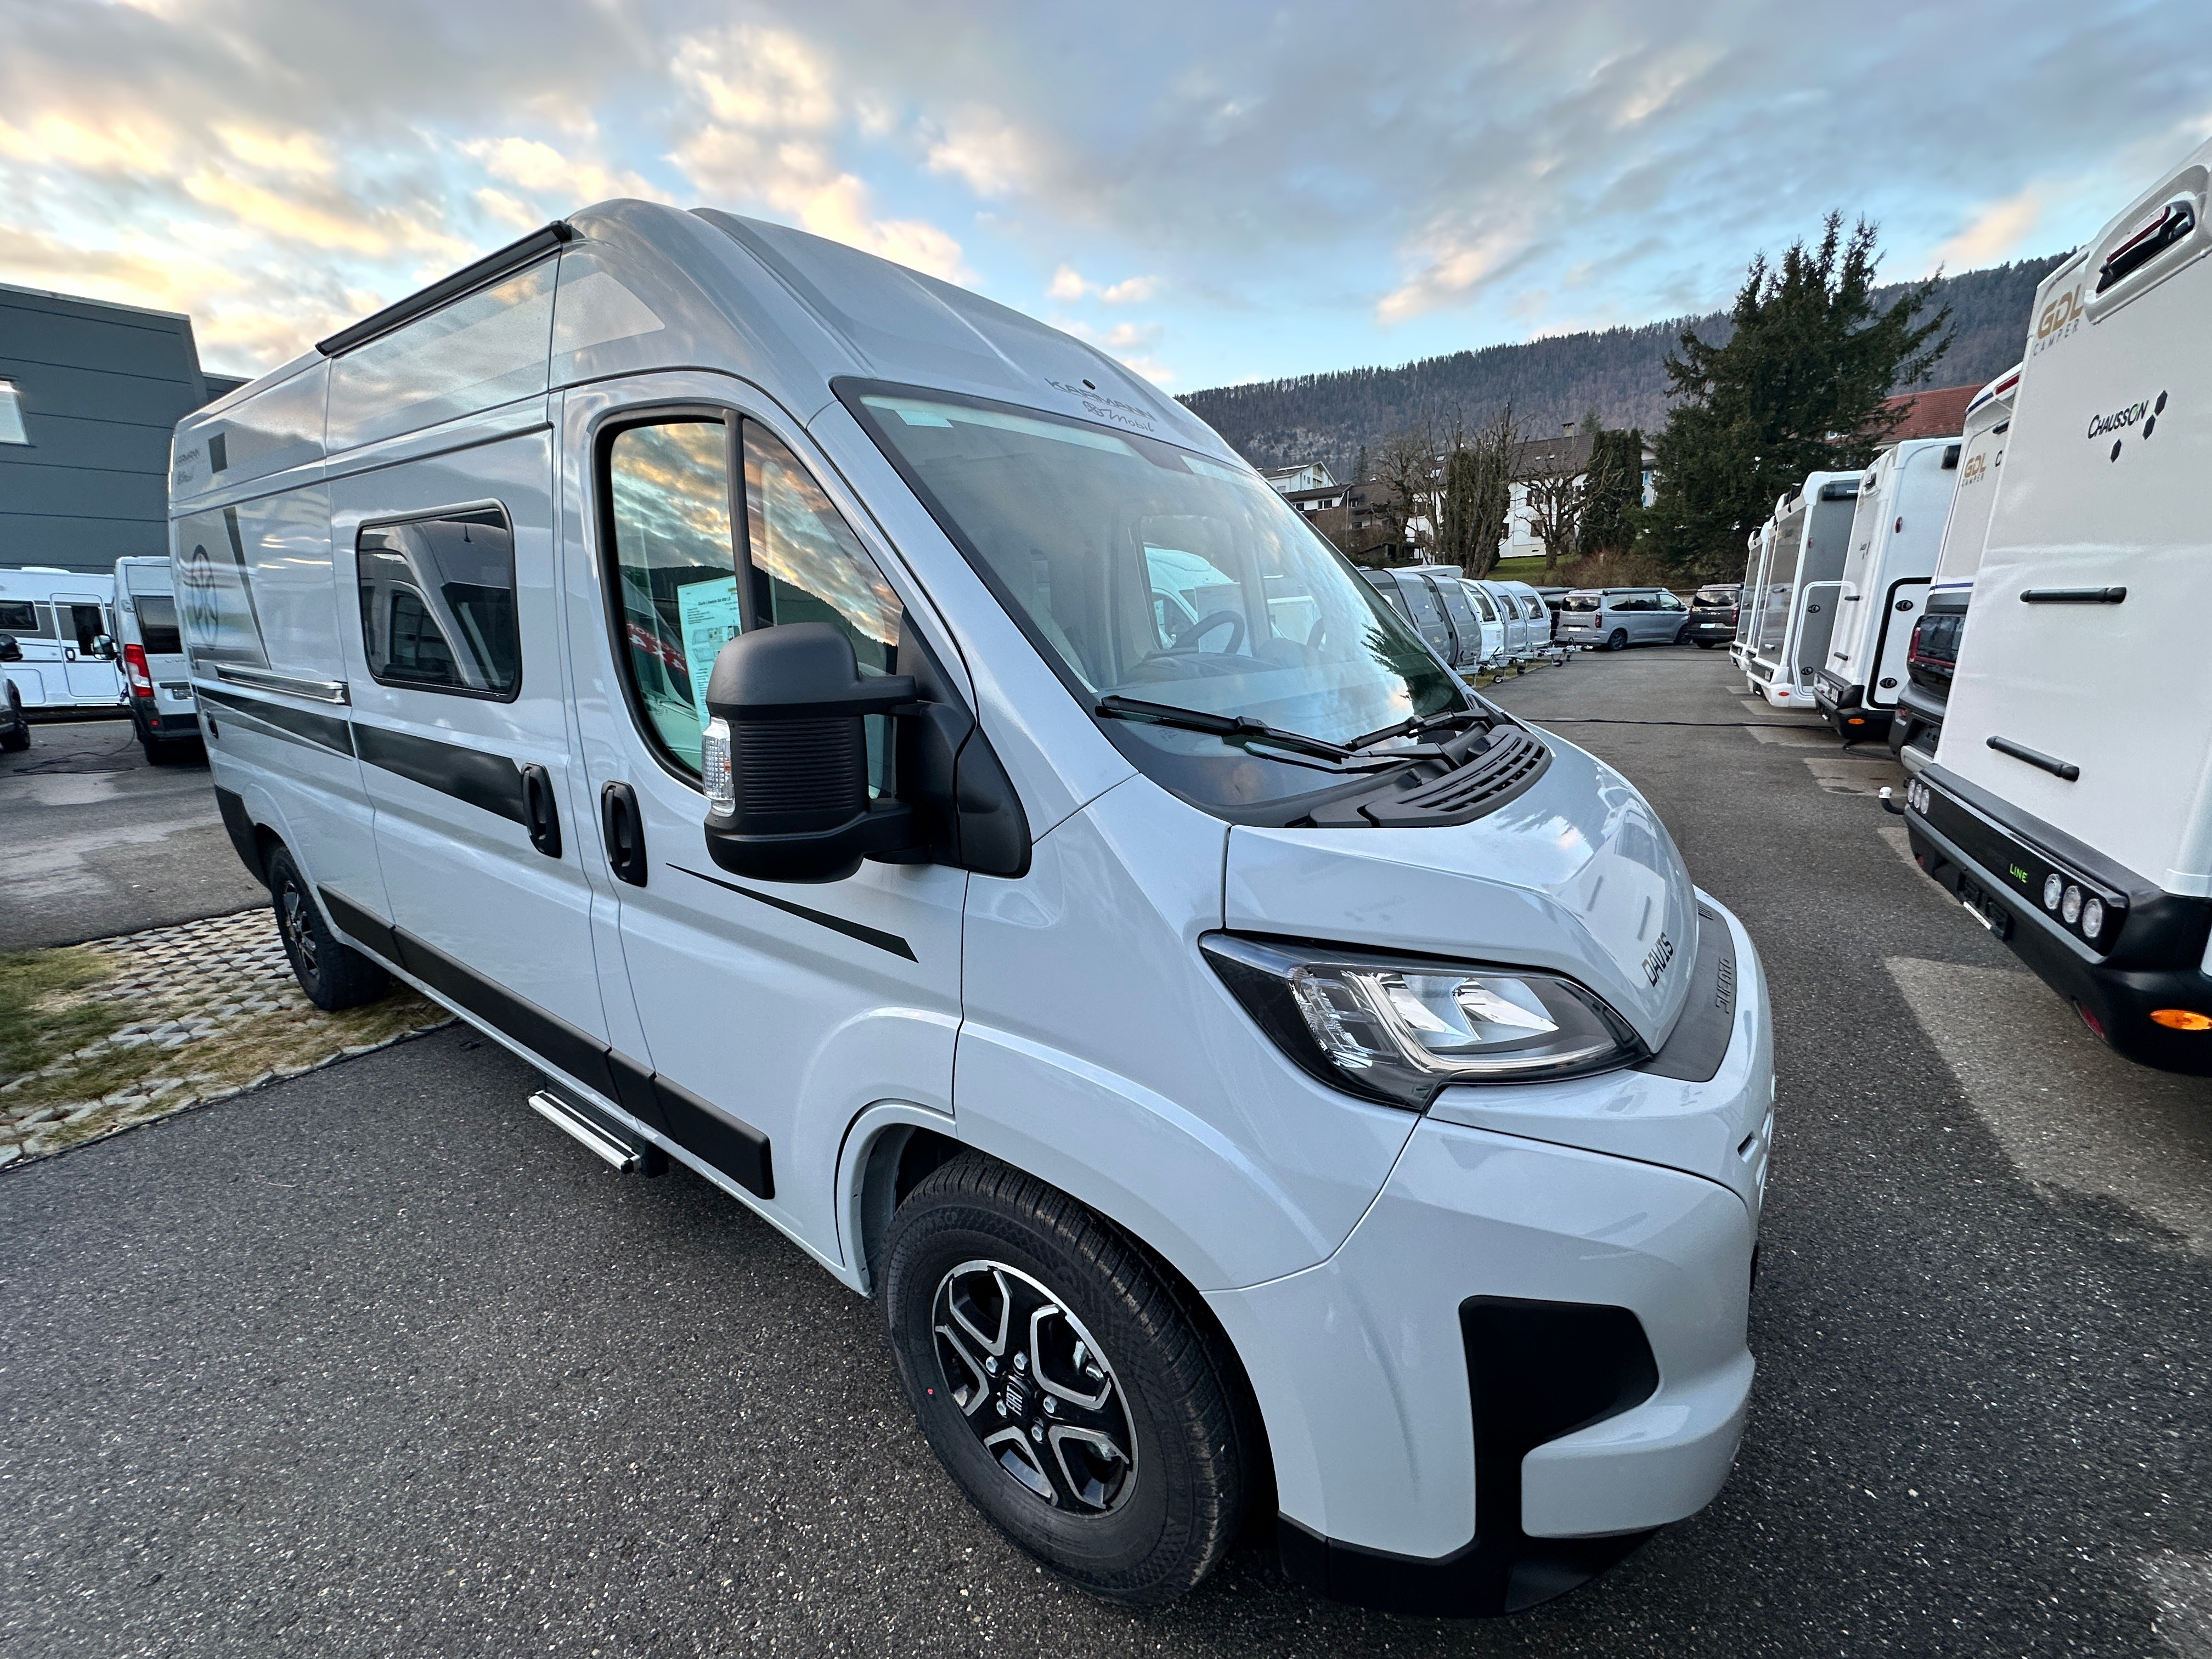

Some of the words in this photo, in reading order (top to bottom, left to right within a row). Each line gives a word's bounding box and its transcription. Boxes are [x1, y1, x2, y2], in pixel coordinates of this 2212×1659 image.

[2038, 283, 2084, 340] GDL
[2033, 318, 2080, 357] CAMPER
[1044, 377, 1158, 422] KARMANN
[1964, 452, 1987, 478] GDL
[2009, 862, 2028, 884] LINE
[1641, 932, 1674, 988] DAVIS
[1715, 956, 1733, 1015] DUCATO
[1006, 1385, 1023, 1417] FIAT
